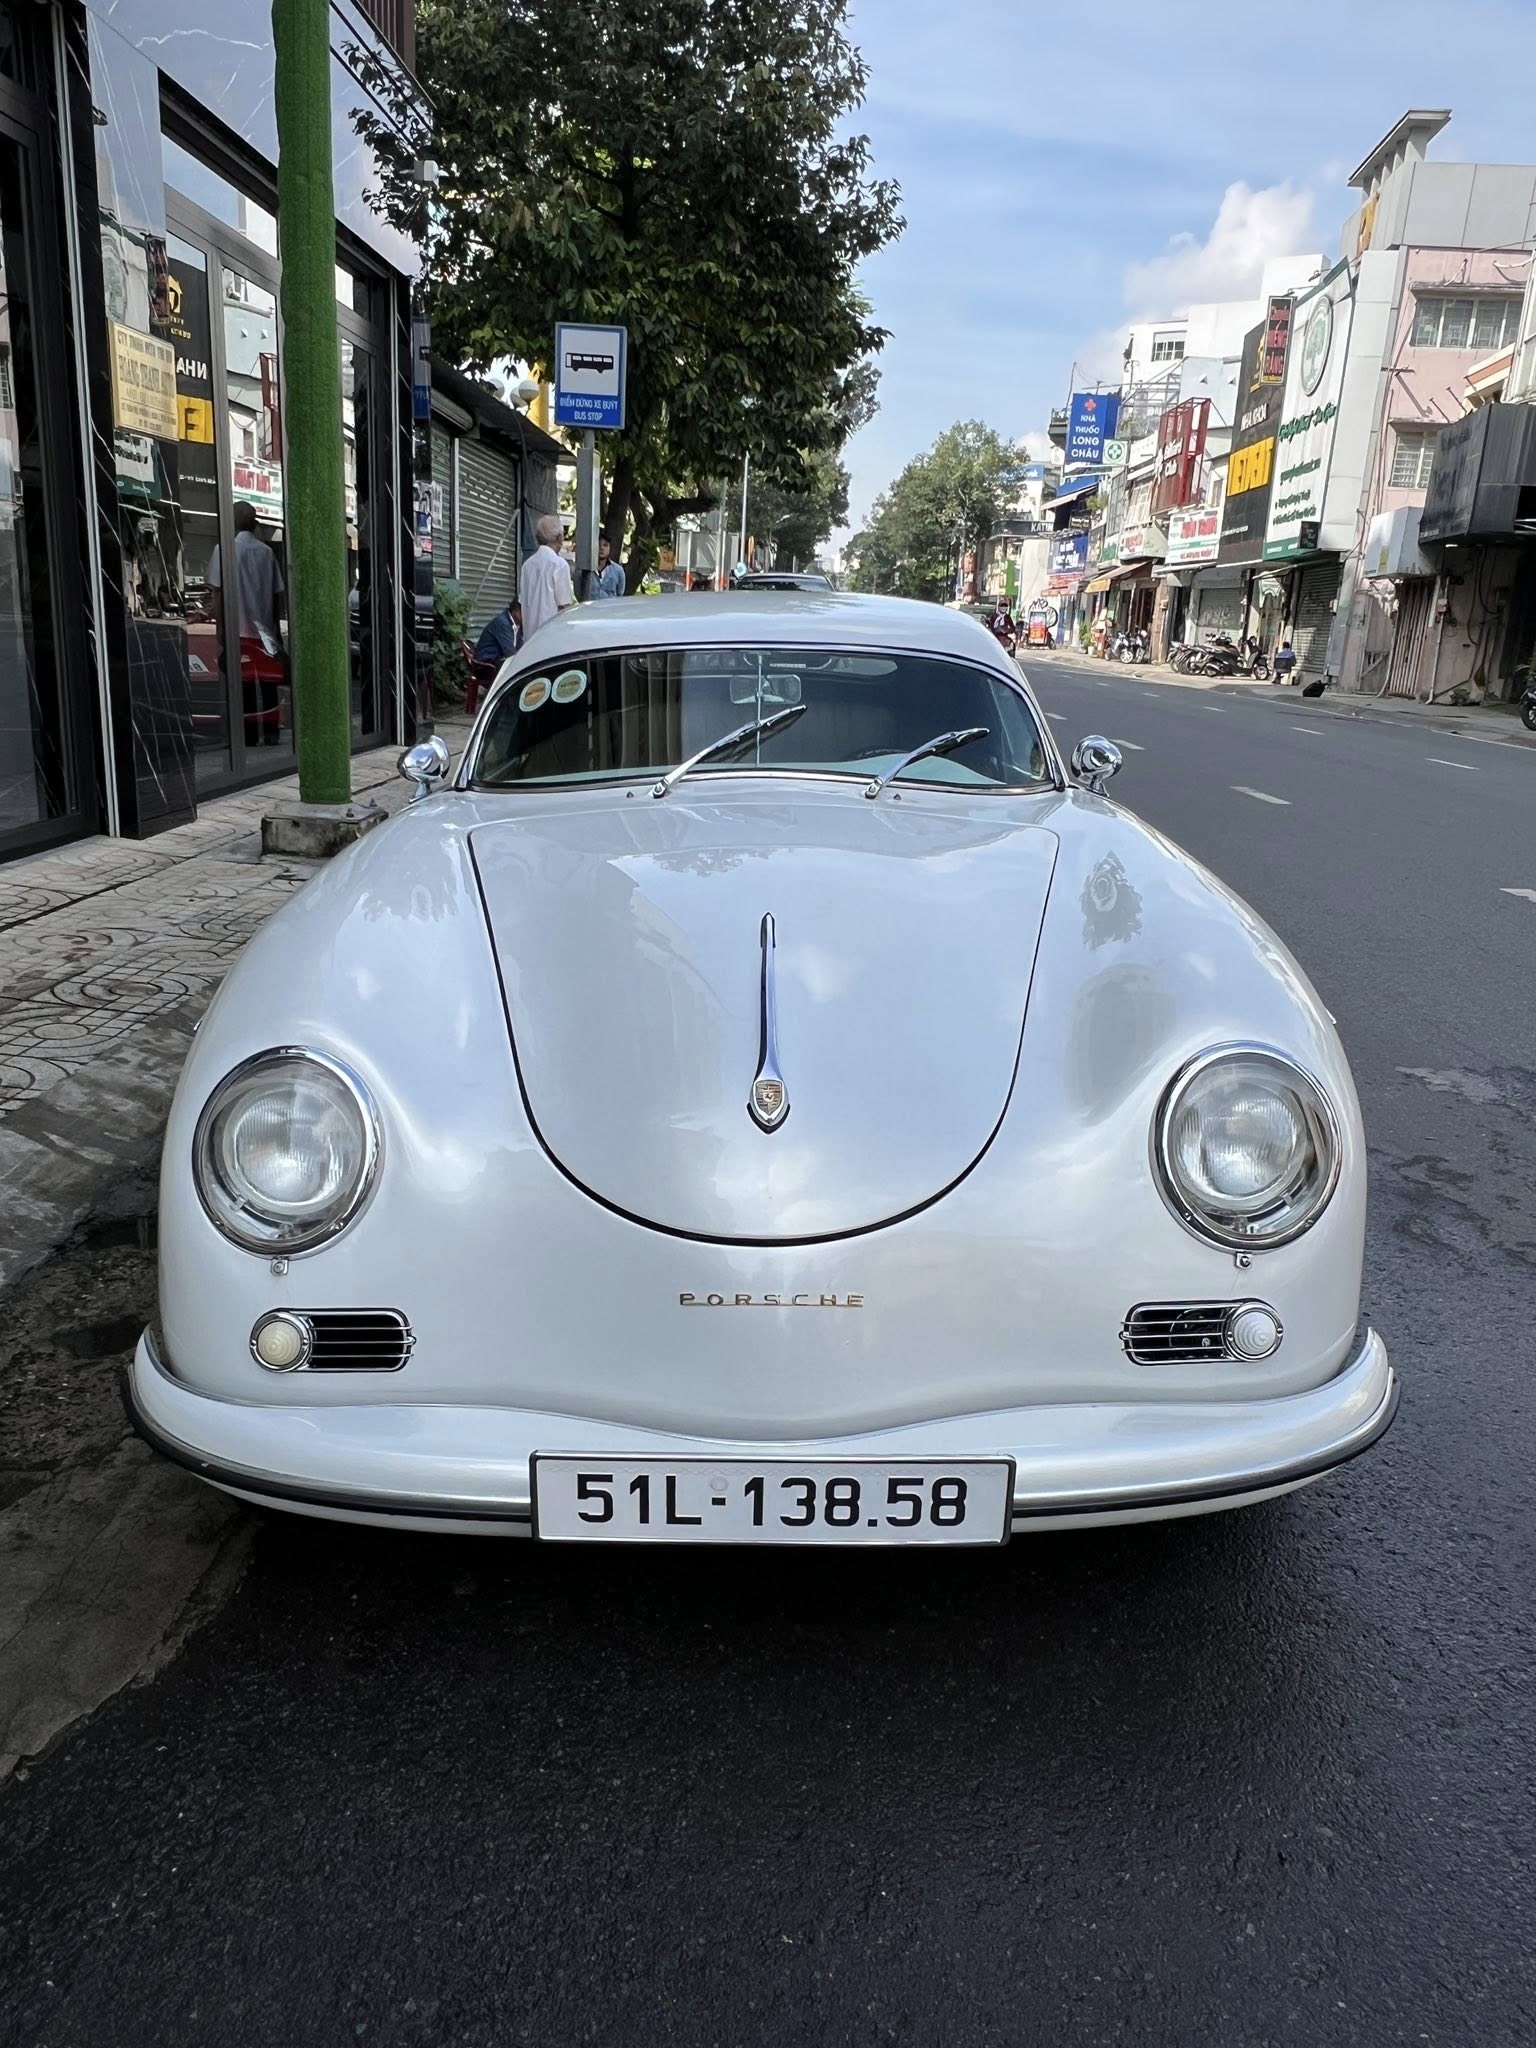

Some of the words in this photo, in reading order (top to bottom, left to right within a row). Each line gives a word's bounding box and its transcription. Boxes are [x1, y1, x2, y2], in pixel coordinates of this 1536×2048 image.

[574, 411, 587, 420] BUS
[587, 411, 603, 421] STOP
[1072, 436, 1100, 446] LONG
[679, 1293, 864, 1307] PORSCHE
[576, 1472, 968, 1528] 51L-138.58
